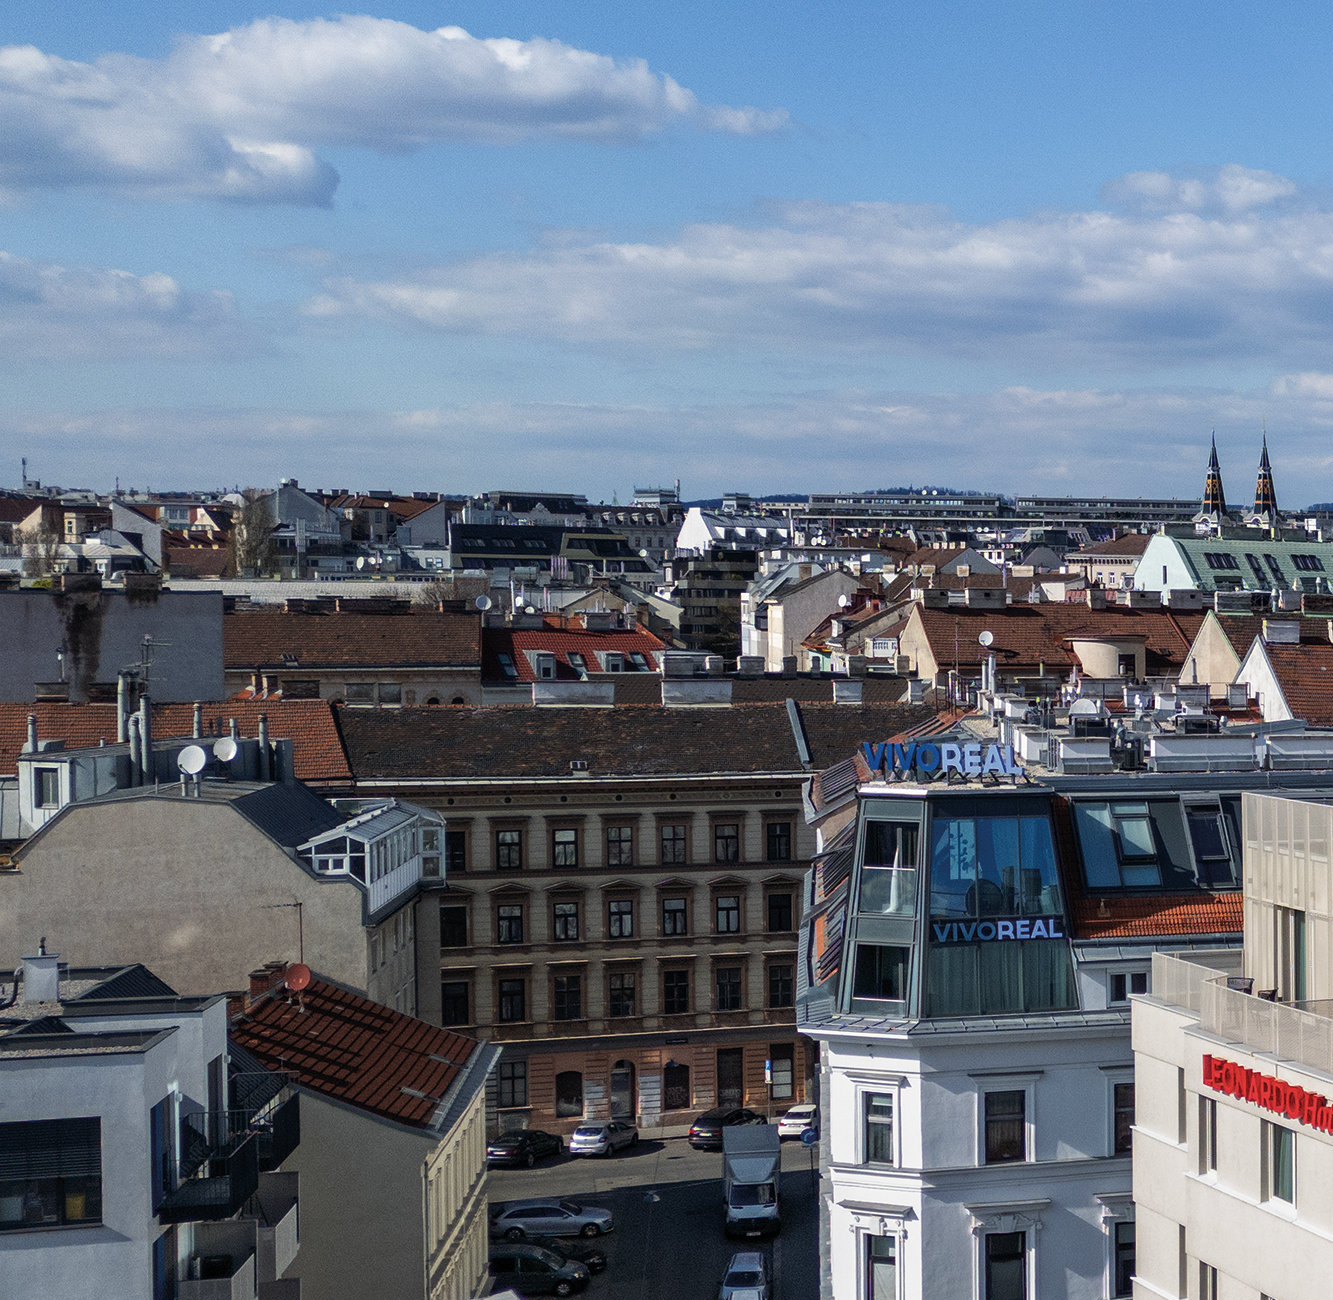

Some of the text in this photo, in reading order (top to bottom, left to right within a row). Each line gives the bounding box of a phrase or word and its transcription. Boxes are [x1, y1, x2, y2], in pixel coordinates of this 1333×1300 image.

[863, 742, 1025, 776] VIVOREAL
[933, 919, 1063, 943] VIVOREAL
[1202, 1054, 1304, 1119] LEONARDO
